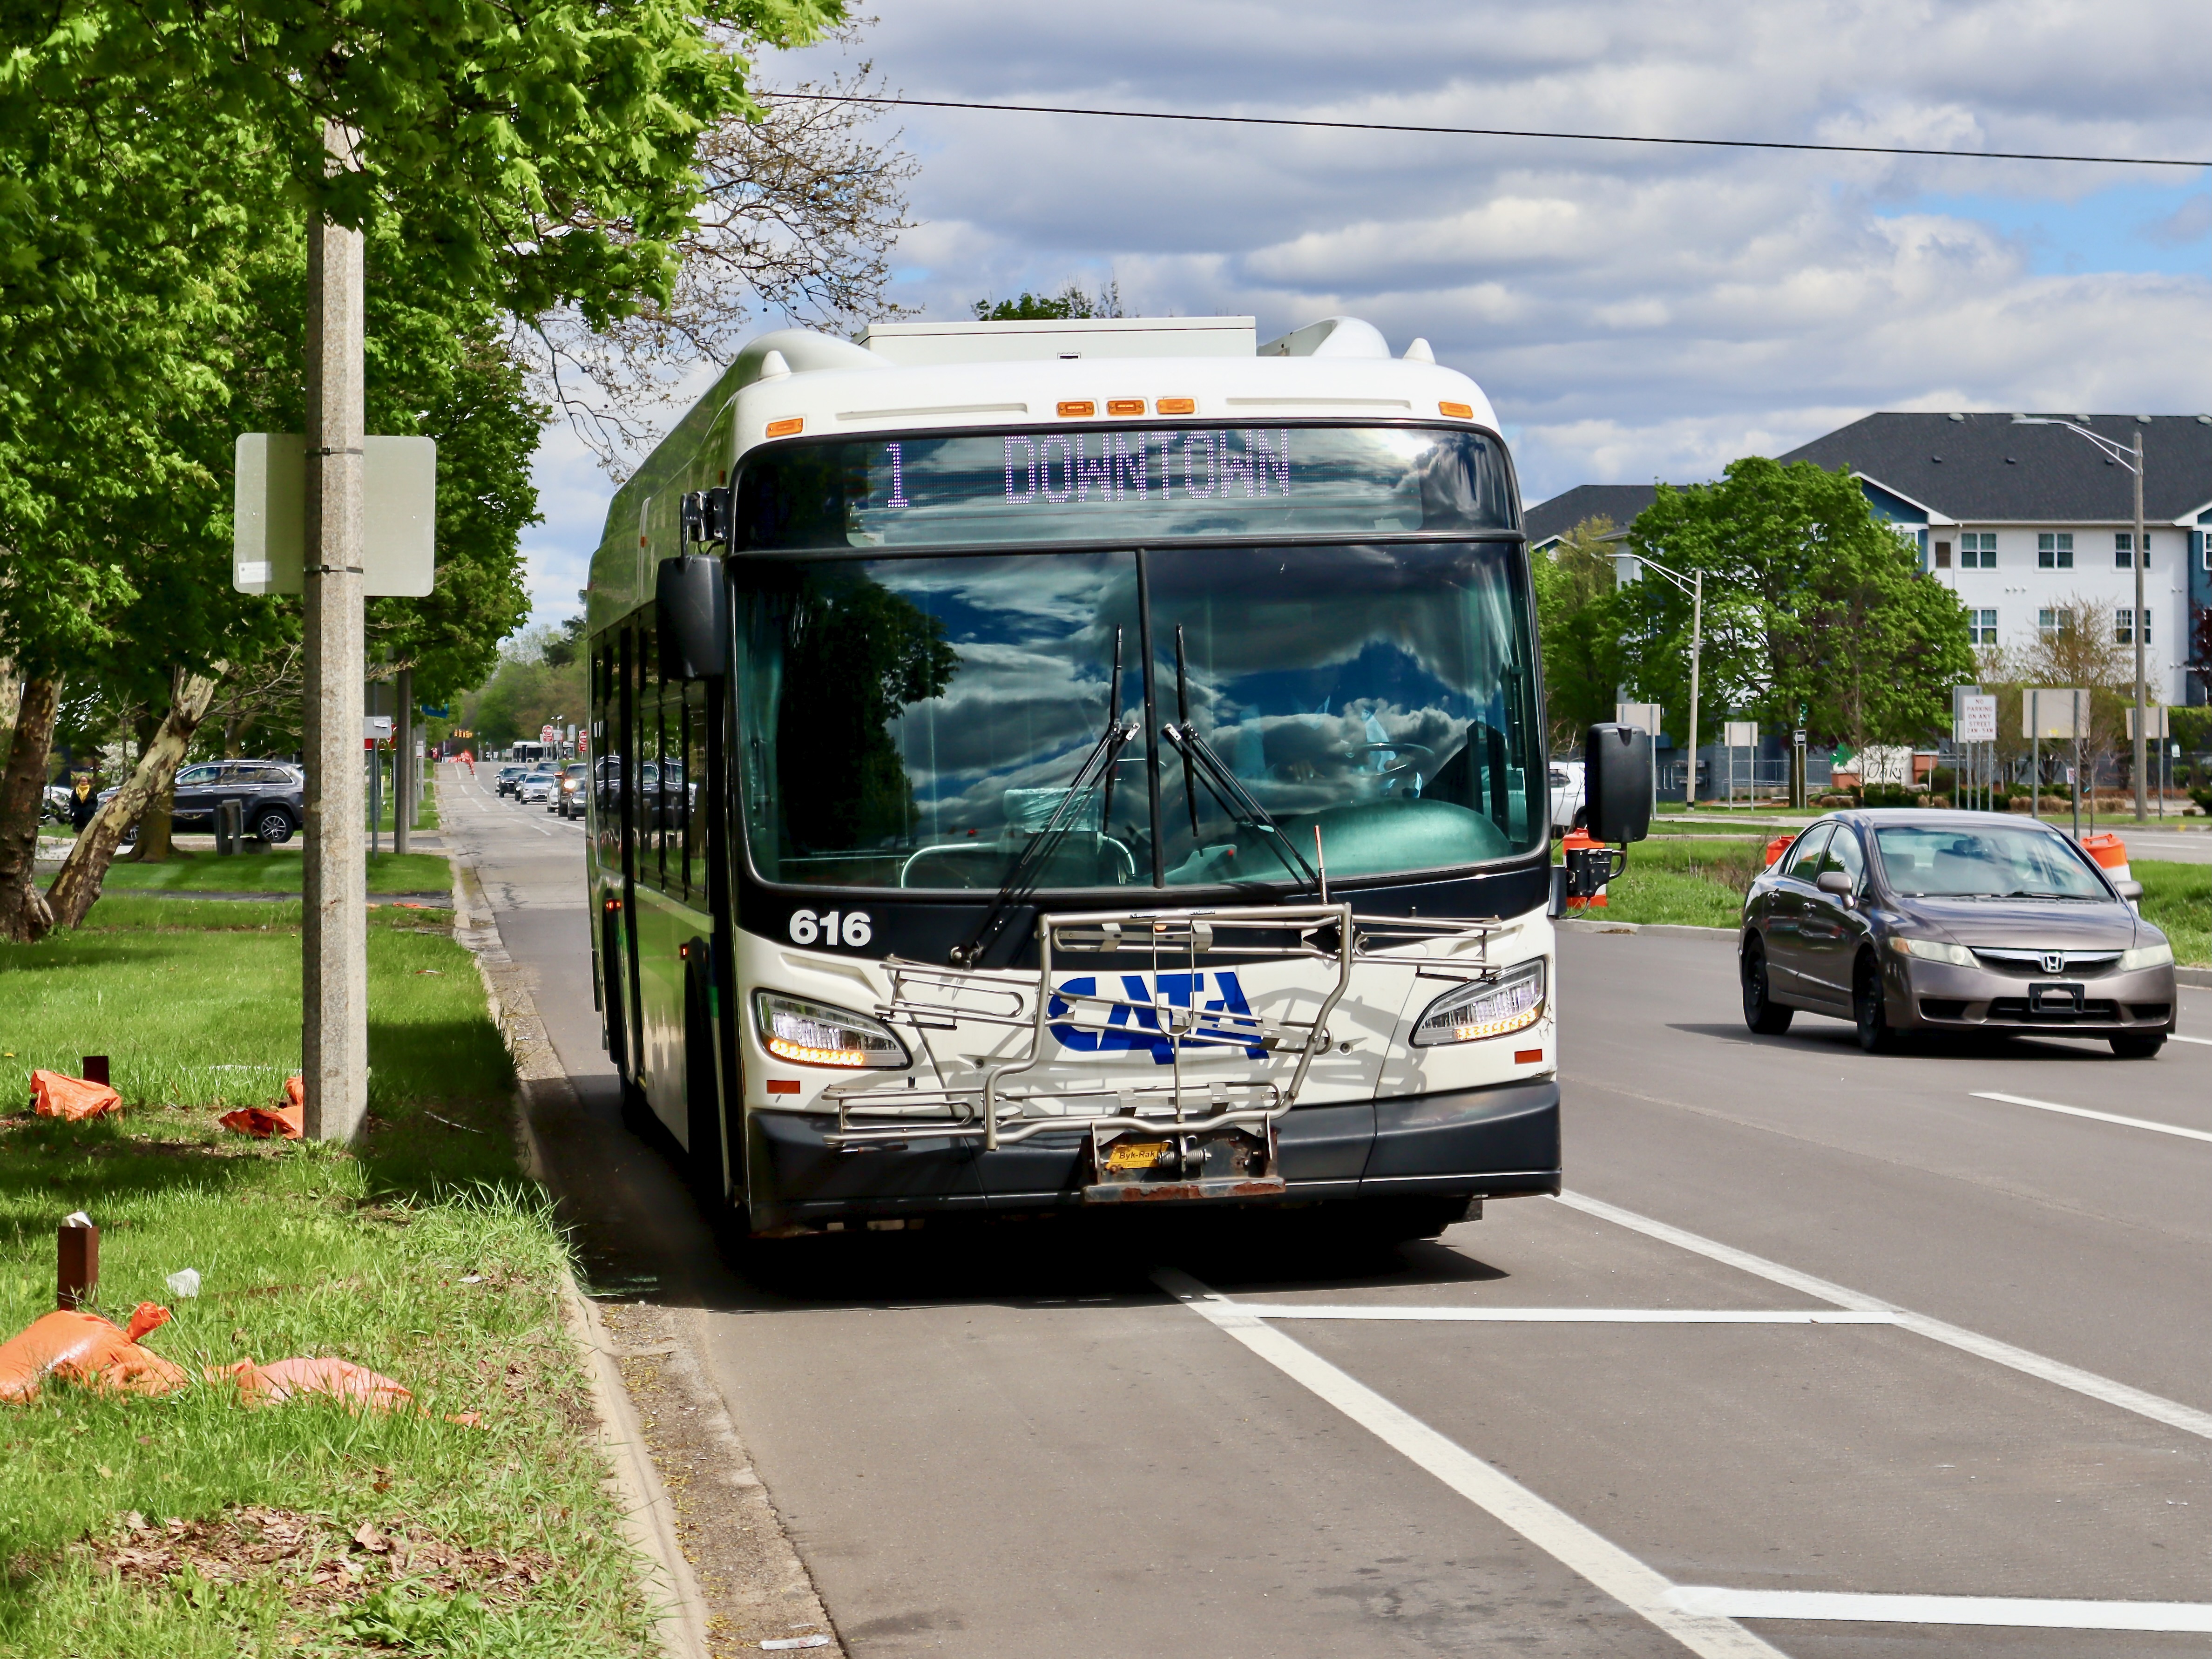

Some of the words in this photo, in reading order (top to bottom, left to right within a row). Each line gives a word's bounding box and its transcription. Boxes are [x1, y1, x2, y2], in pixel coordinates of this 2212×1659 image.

[886, 443, 908, 508] 1
[1004, 428, 1290, 504] DOWNTOWN
[789, 909, 871, 947] 616
[1048, 972, 1269, 1065] CATA
[1119, 1151, 1155, 1161] Byk-Rak
